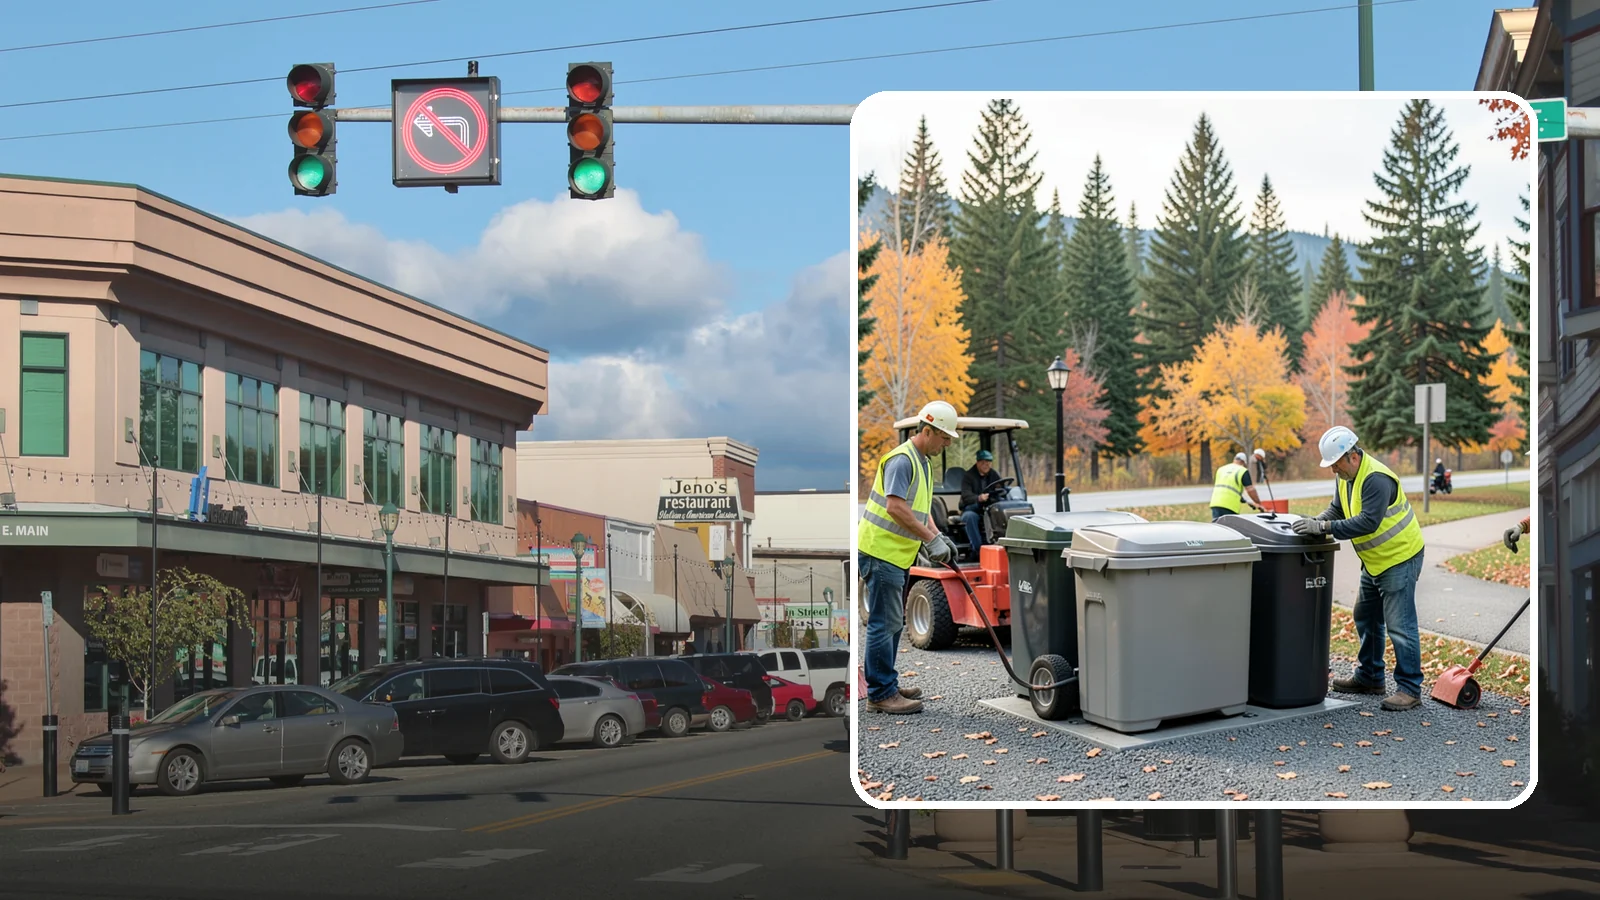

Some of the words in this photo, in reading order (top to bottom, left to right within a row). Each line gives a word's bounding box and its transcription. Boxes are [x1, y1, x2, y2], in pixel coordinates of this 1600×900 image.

[670, 480, 727, 494] Jeno's
[666, 496, 731, 509] restaurant
[659, 510, 681, 519] Italian
[686, 510, 714, 519] American
[715, 509, 737, 519] Cuisine
[2, 525, 13, 536] E.
[15, 525, 49, 536] MAIN
[797, 607, 828, 616] Street
